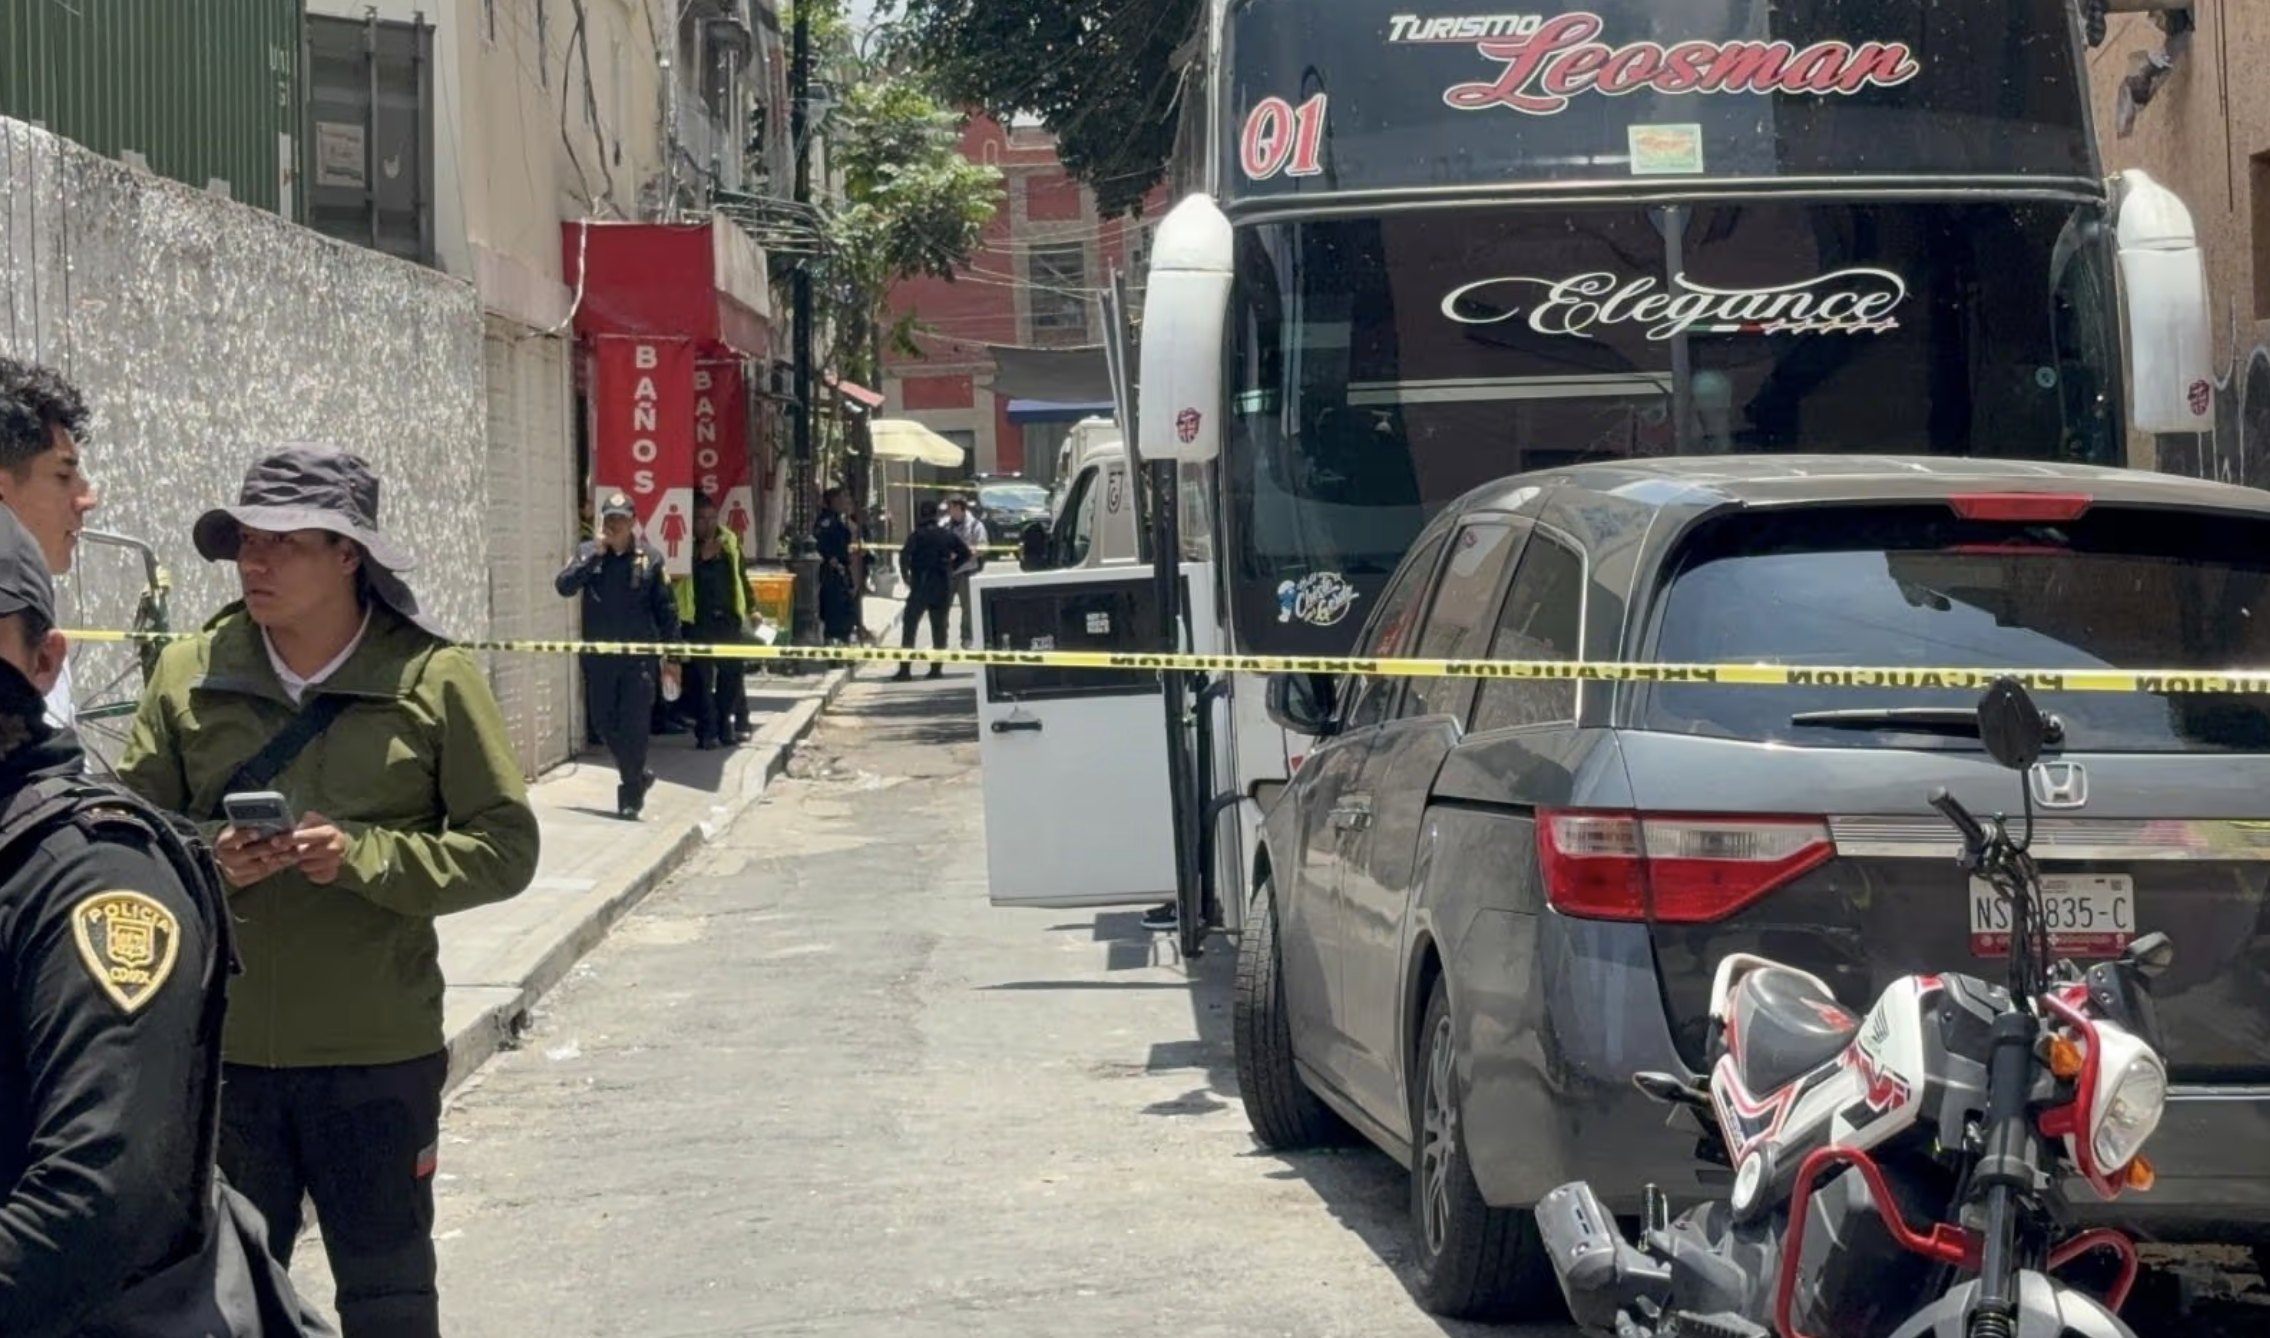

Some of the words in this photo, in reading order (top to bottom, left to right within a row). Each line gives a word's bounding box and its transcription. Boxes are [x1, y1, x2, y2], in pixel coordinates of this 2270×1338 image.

[1241, 92, 1327, 181] 01
[1440, 267, 1907, 341] Elegance
[632, 345, 658, 494] BAÑOS
[694, 371, 719, 494] BAÑOS
[88, 901, 170, 934] POLICIA
